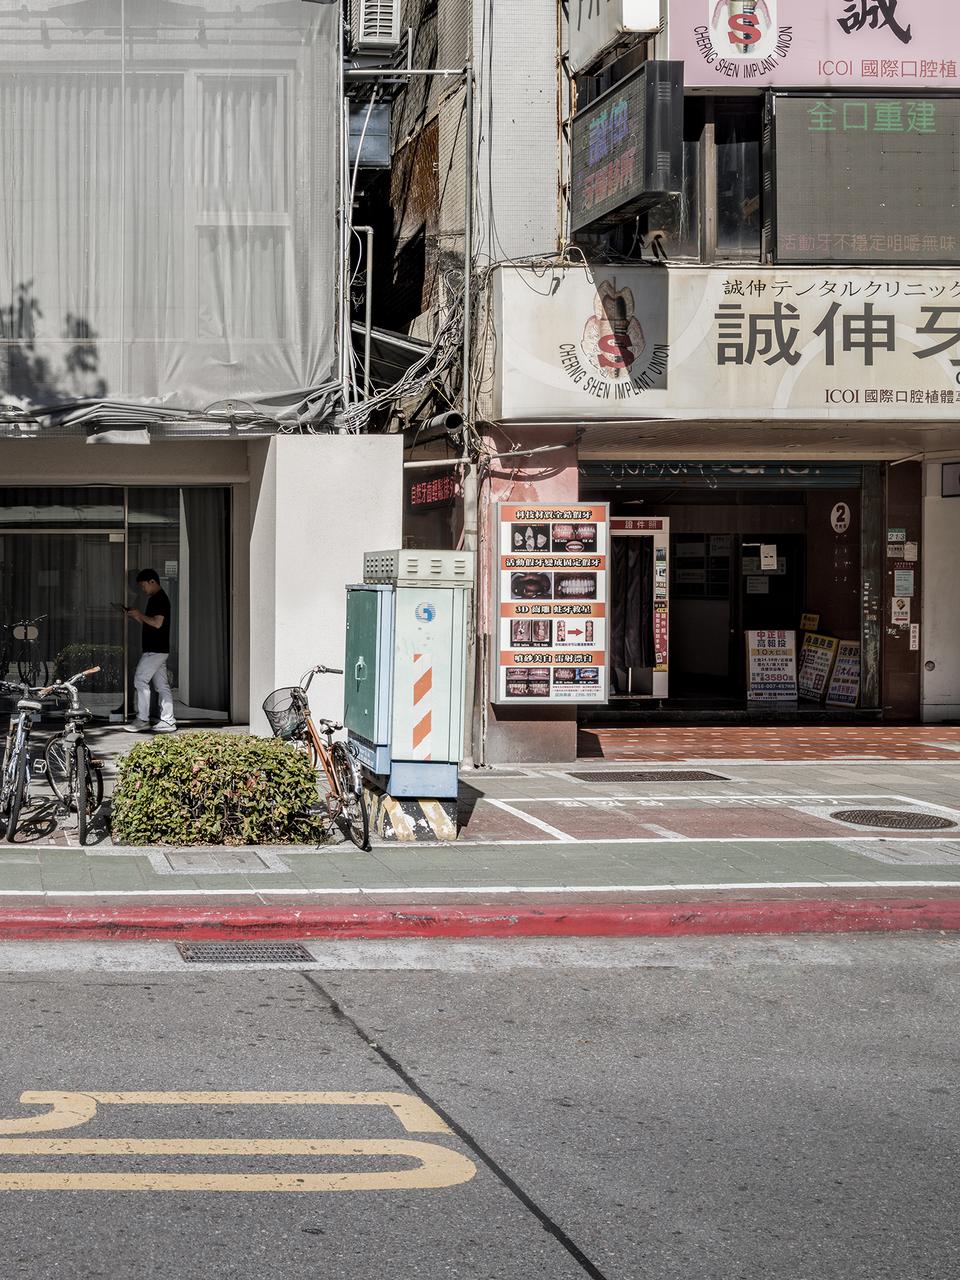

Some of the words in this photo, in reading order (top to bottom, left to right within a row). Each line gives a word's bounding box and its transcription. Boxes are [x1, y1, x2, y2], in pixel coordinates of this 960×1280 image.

[693, 25, 718, 65] CHERNG
[715, 58, 740, 79] SHEN
[743, 54, 780, 79] IMPLANT
[774, 25, 793, 58] UNION
[818, 60, 854, 76] ICOI
[807, 101, 937, 133] 全口重建
[559, 343, 588, 385] CHERNG
[583, 376, 611, 399] SHEN
[614, 370, 656, 400] IMPLANT
[647, 343, 670, 375] UNION
[825, 389, 859, 403] ICOI
[836, 505, 846, 523] 2
